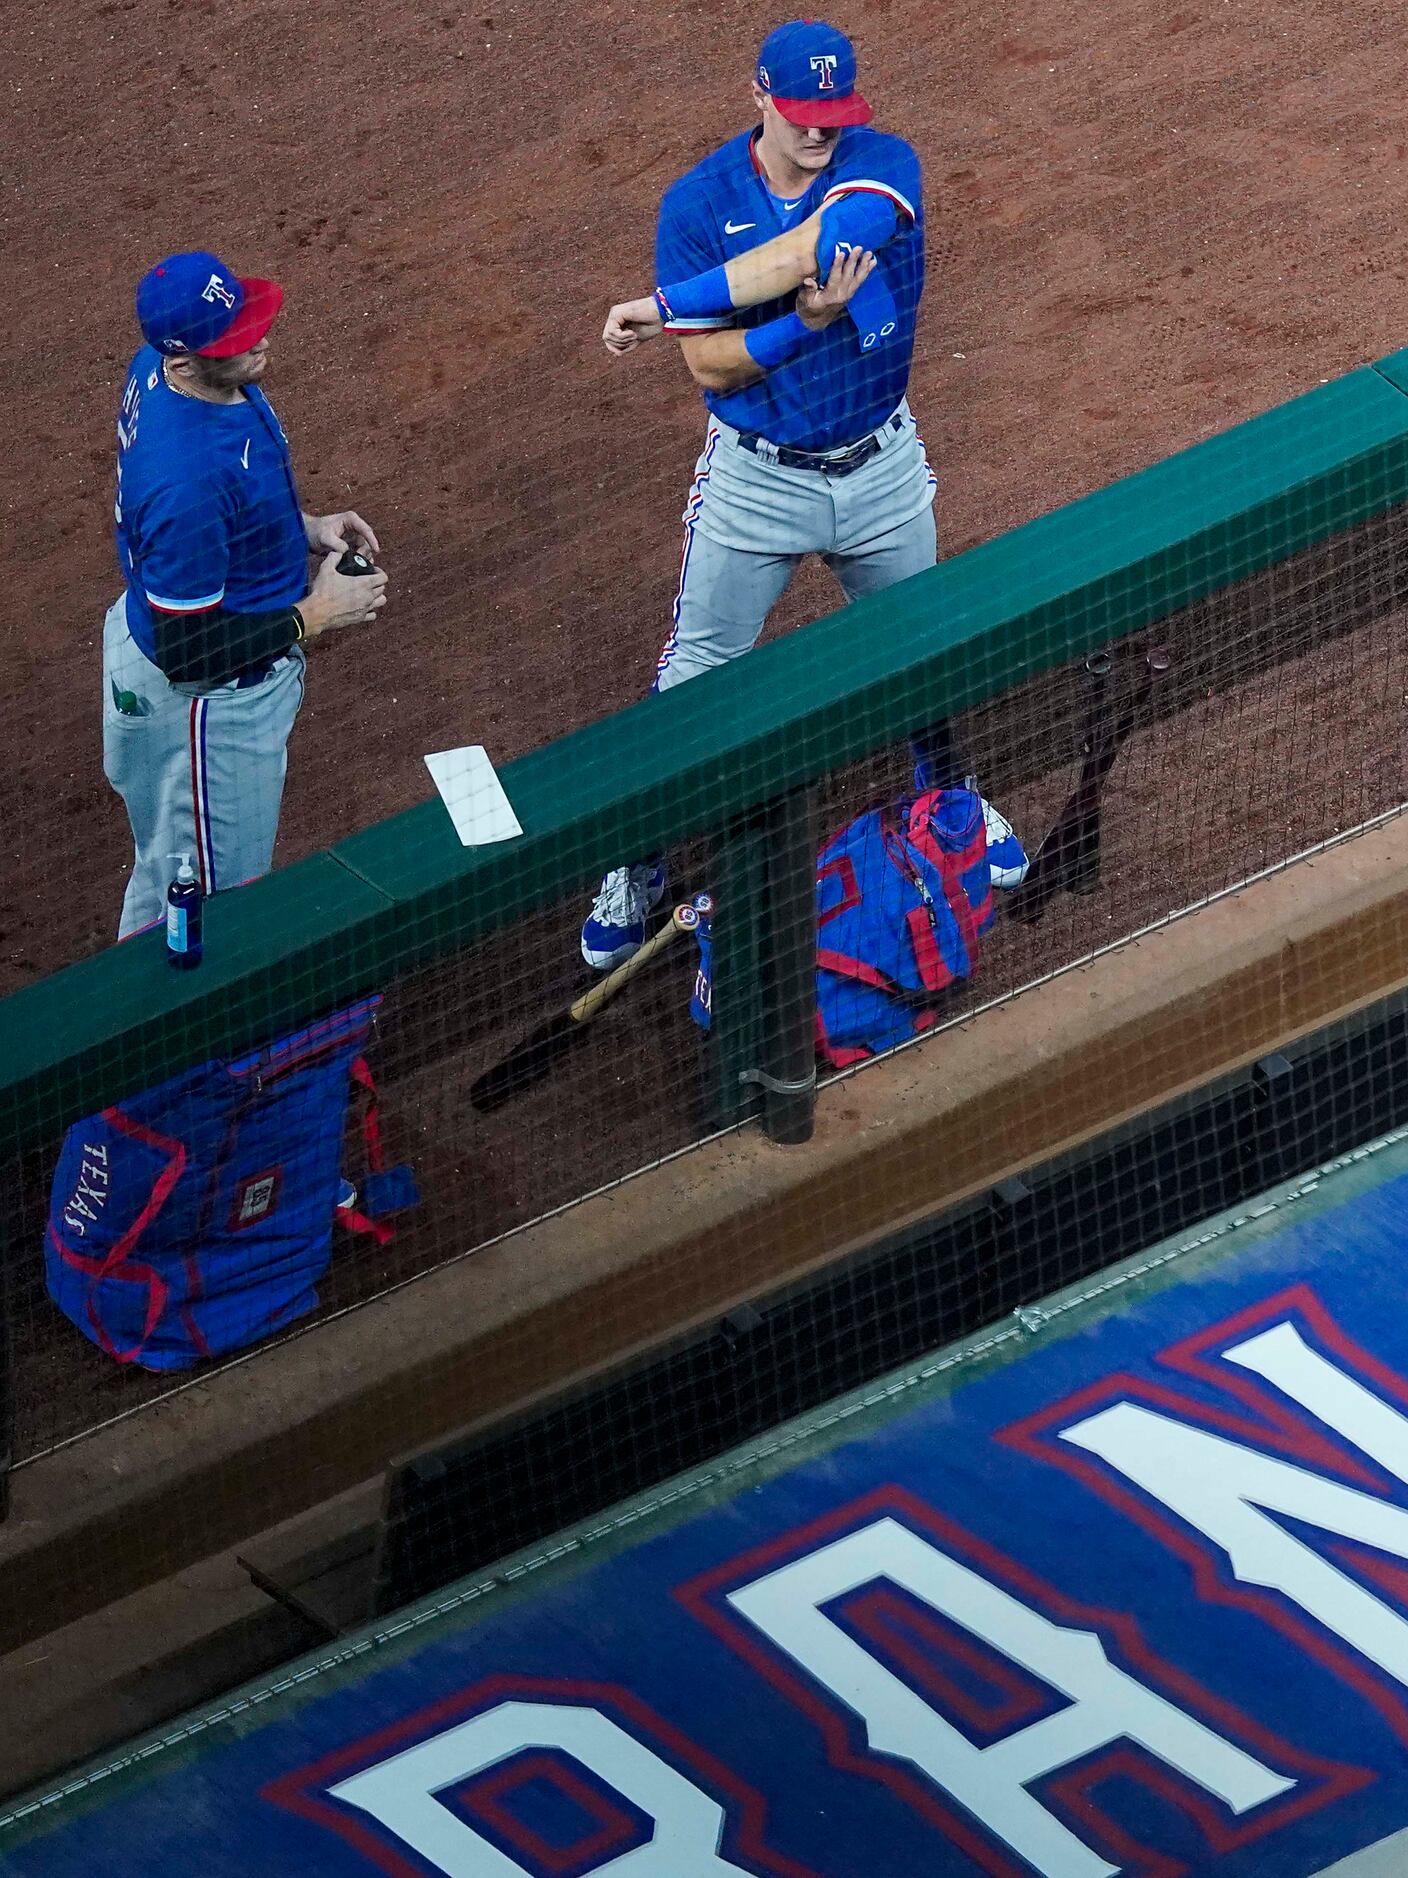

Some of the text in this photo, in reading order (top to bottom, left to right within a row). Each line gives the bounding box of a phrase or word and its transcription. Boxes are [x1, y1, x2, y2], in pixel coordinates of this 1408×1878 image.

[809, 55, 837, 89] T
[201, 273, 236, 309] T
[64, 1143, 108, 1236] TEXAS
